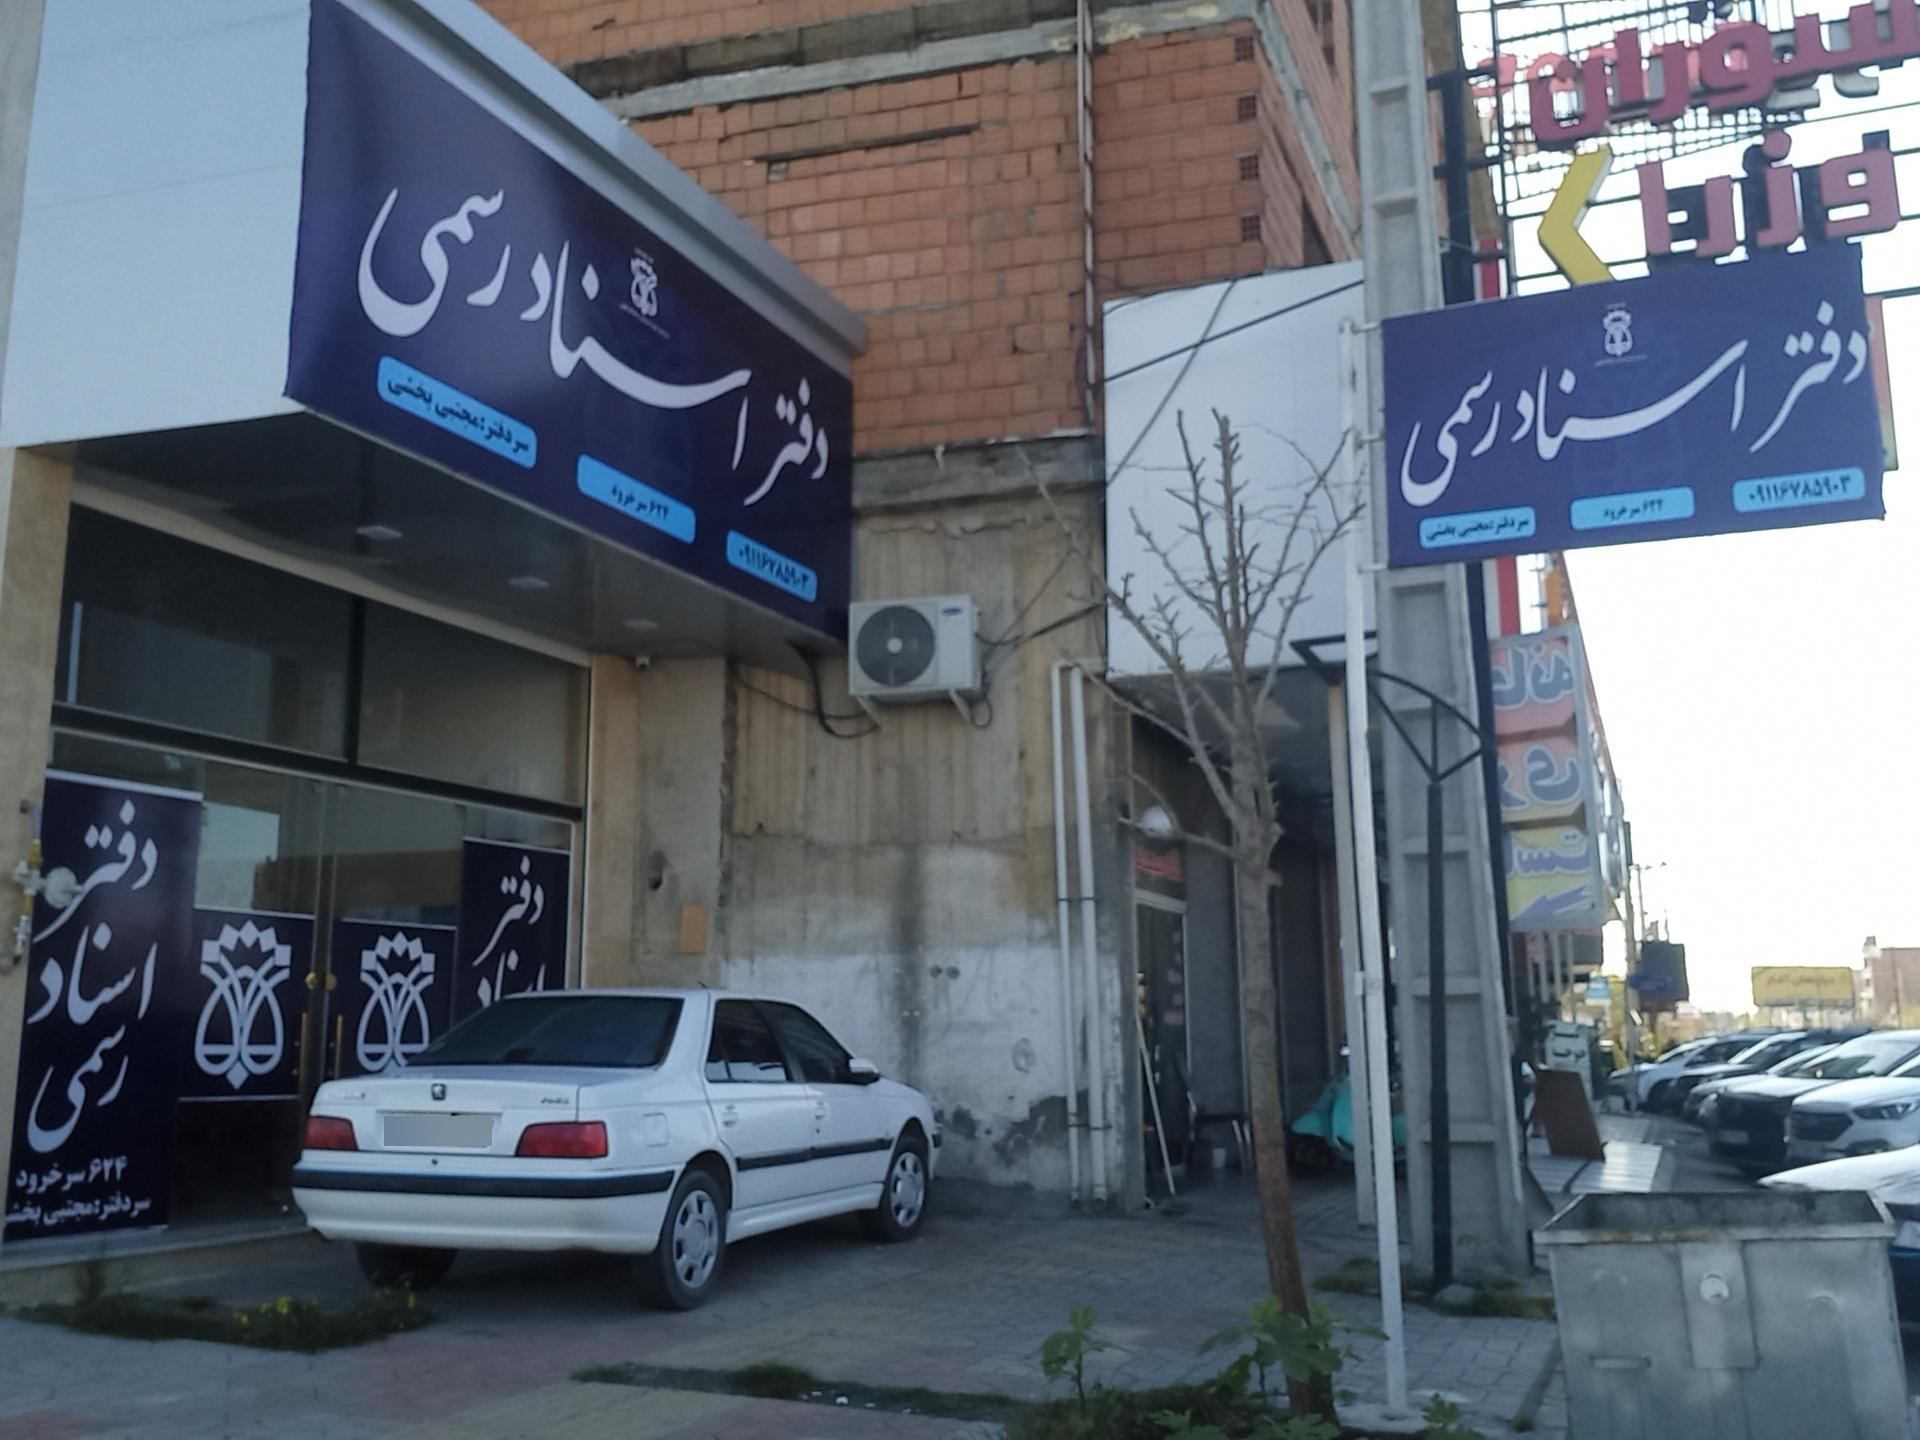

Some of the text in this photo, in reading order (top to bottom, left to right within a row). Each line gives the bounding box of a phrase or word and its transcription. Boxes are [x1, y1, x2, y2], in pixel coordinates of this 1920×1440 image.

[358, 187, 830, 506] دفتر اسناد رسمی
[1400, 301, 1868, 507] دفتر اسناد رسمی
[33, 799, 158, 943] دفتر
[473, 855, 544, 967] دفتر
[27, 922, 158, 1025] اسناد
[27, 1023, 129, 1153] رسمی
[88, 1155, 128, 1184] ۶۲۴
